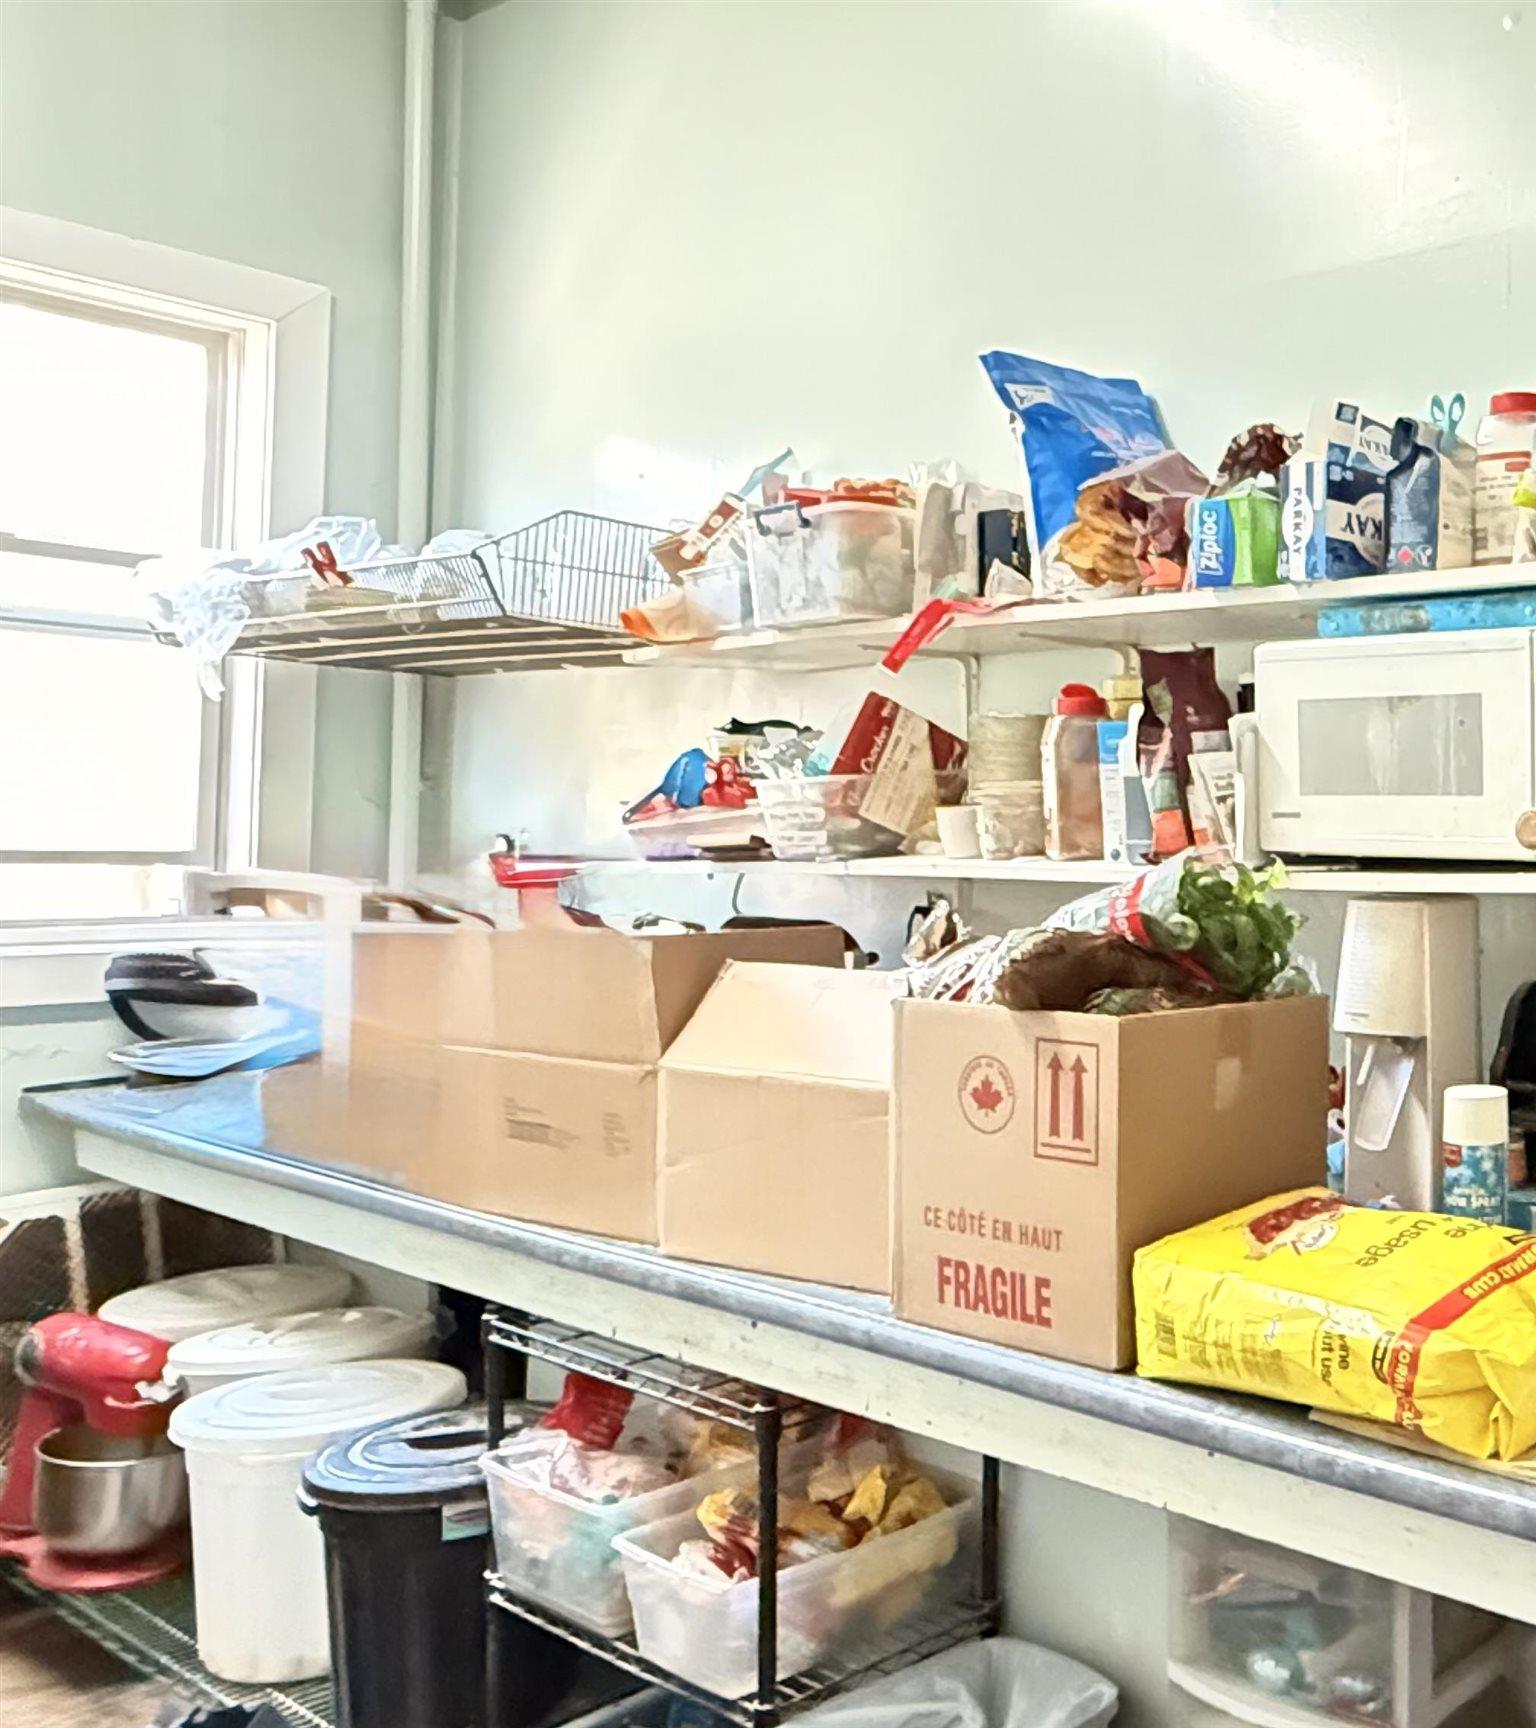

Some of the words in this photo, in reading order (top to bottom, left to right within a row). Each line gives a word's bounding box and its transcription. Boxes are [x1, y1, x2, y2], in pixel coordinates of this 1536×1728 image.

[1197, 509, 1225, 576] Ziploc
[1292, 486, 1304, 556] PARKAY
[1340, 510, 1384, 542] KAY
[923, 1205, 943, 1229] CE
[947, 1207, 987, 1240] CÔTÉ
[992, 1221, 1013, 1243] EN
[1019, 1230, 1064, 1253] HAUT
[1355, 1217, 1437, 1268] usage
[937, 1255, 1053, 1329] FRAGILE
[1462, 1270, 1502, 1300] CLUB
